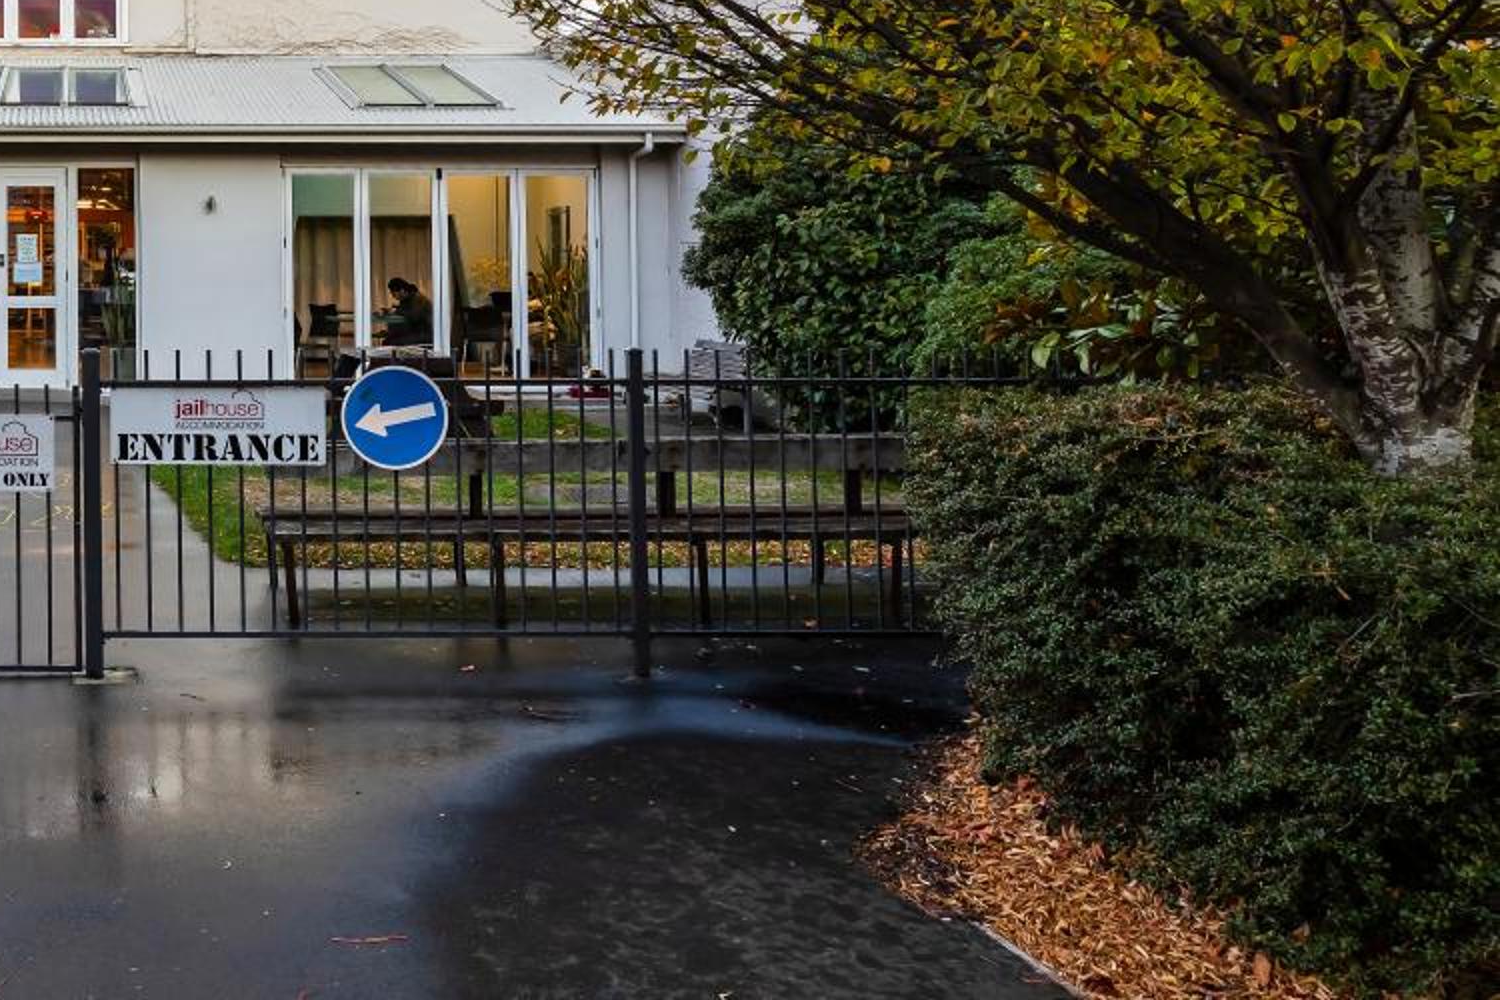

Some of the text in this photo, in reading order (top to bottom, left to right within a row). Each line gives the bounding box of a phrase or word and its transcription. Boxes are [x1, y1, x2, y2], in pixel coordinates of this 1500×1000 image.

[175, 400, 260, 419] jailhouse
[175, 421, 265, 429] ACCOMMODATION
[117, 433, 320, 461] ENTRANCE
[3, 472, 50, 487] ONLY
